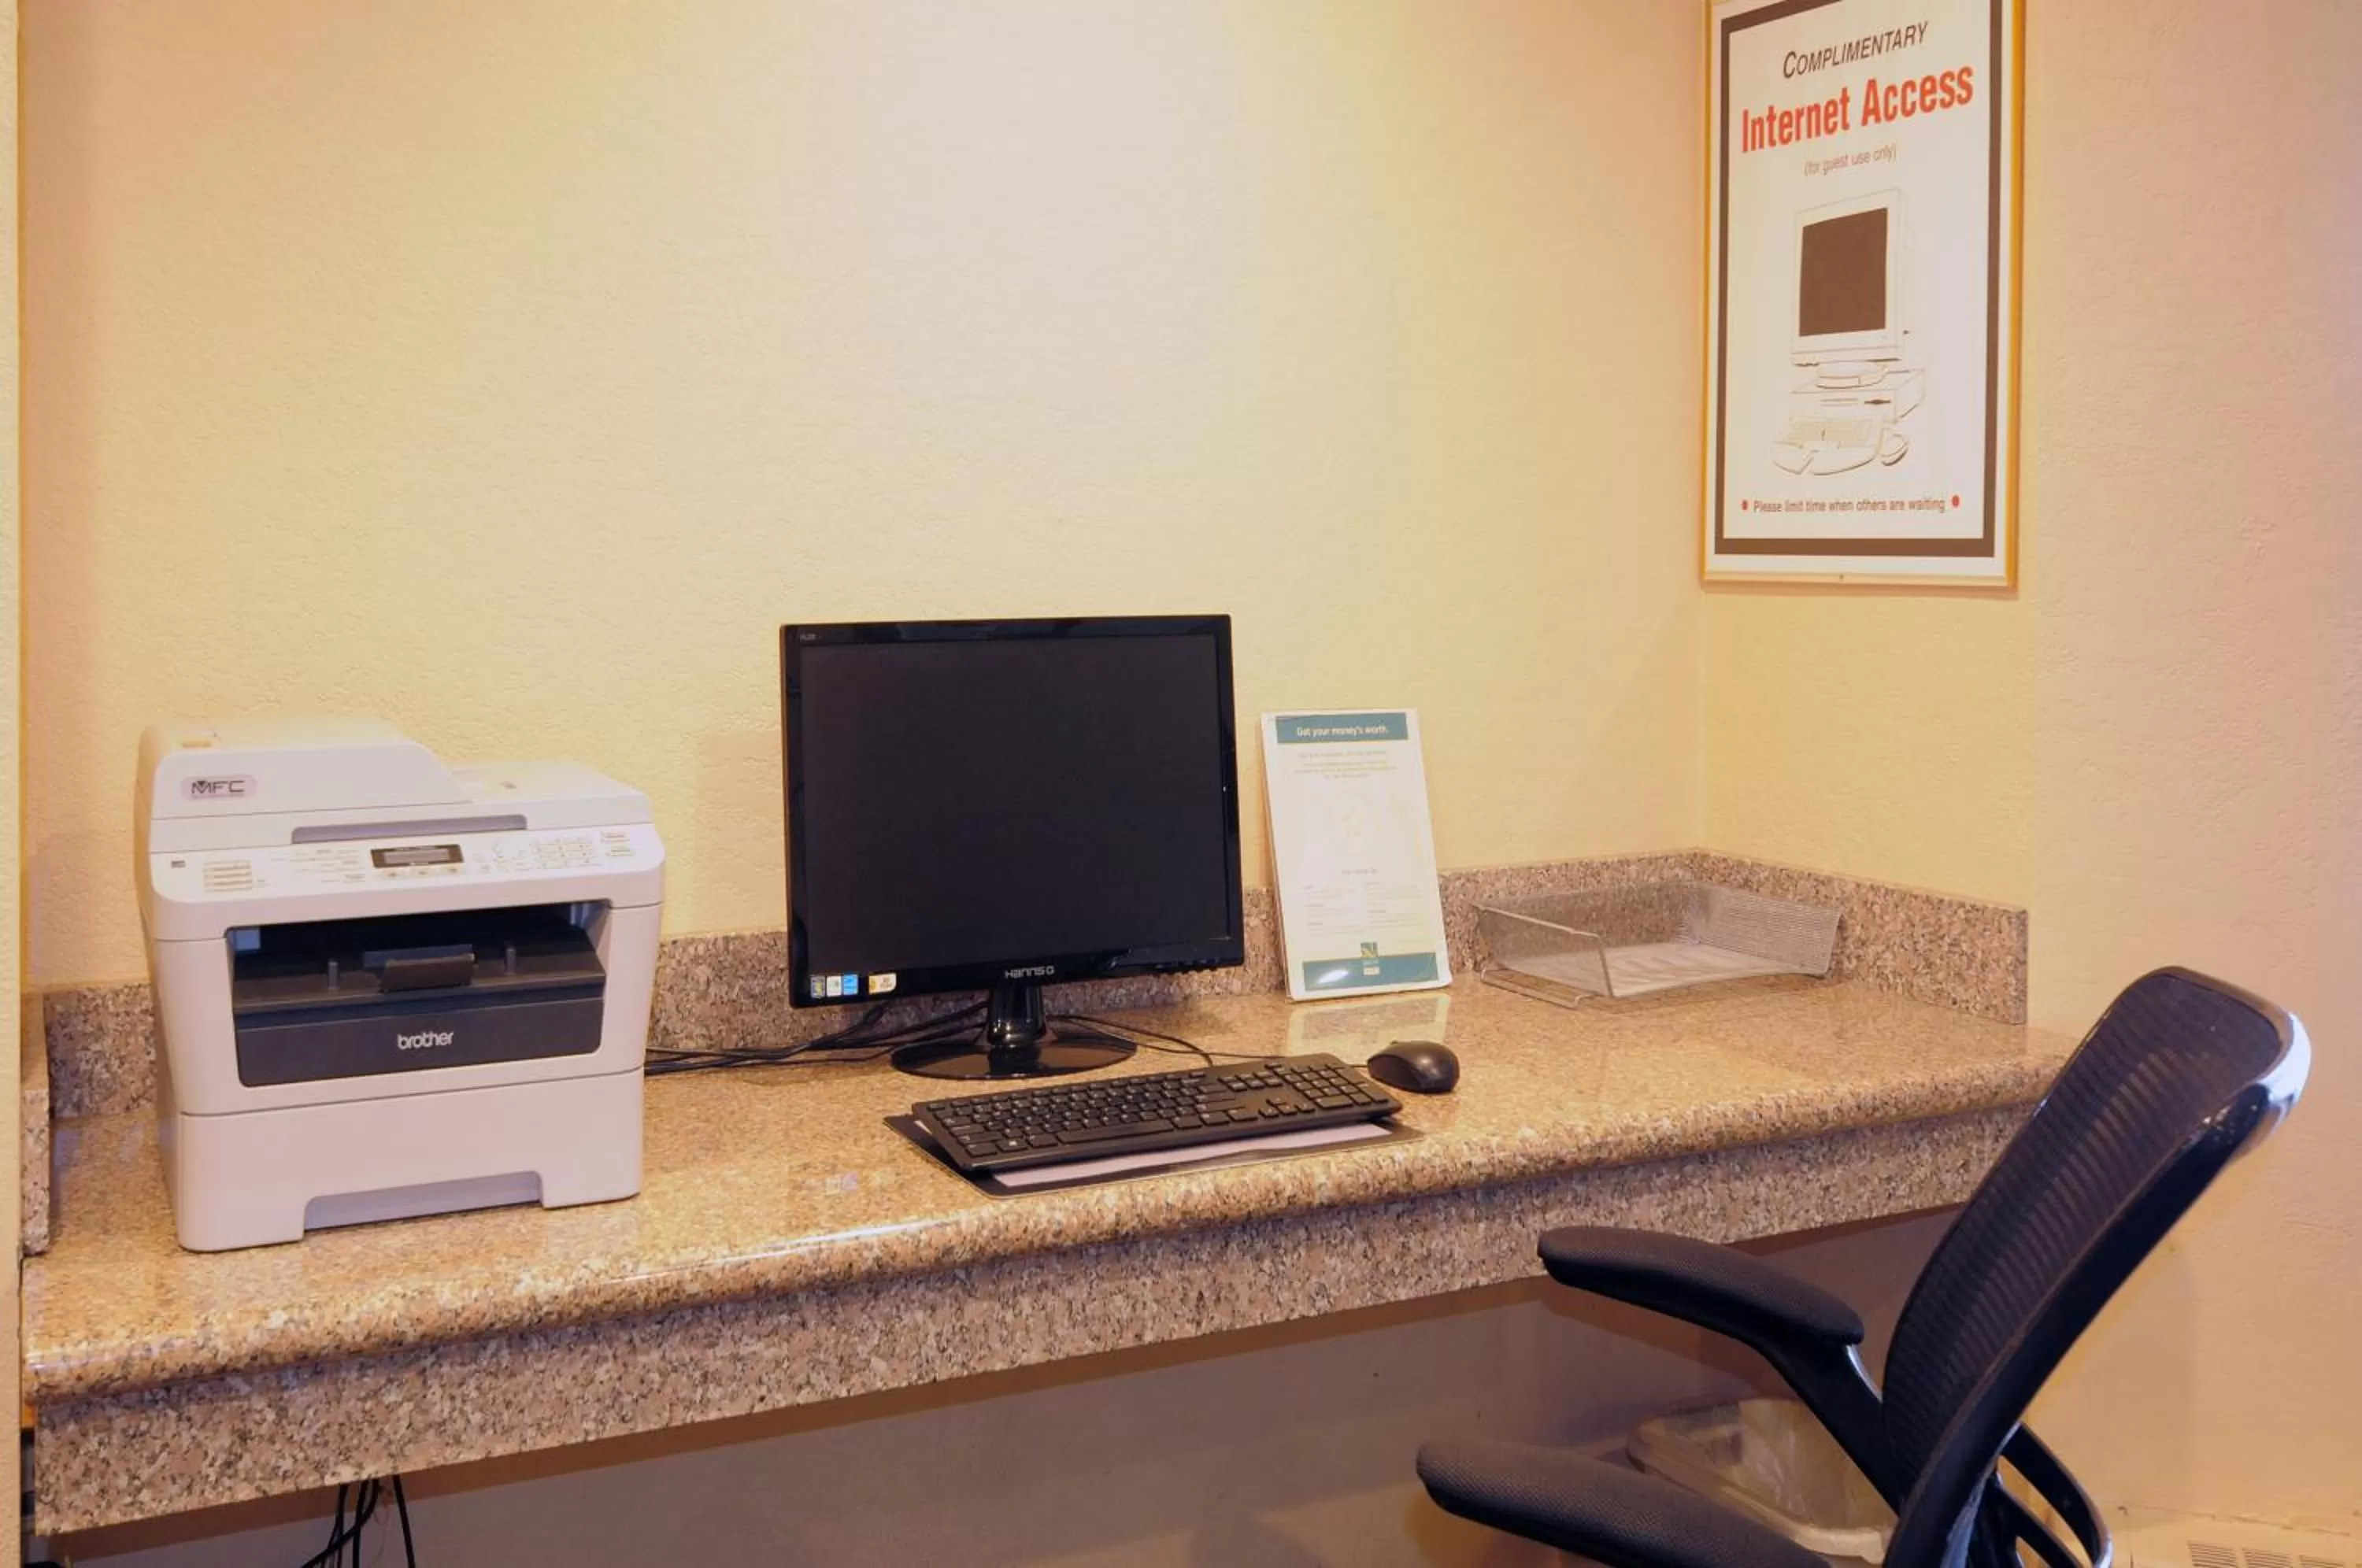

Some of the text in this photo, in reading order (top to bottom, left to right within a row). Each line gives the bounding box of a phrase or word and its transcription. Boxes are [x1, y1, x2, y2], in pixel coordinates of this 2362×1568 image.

[1783, 20, 1929, 80] COMPLIMENTARY
[1742, 65, 1974, 153] Internet Access
[1823, 153, 1849, 176] guest
[1851, 151, 1871, 165] use
[1873, 143, 1897, 165] only)
[1753, 497, 1945, 513] Please limit time when others are waiting
[1312, 728, 1330, 738] your
[191, 780, 246, 794] MFC
[397, 1030, 454, 1050] brother
